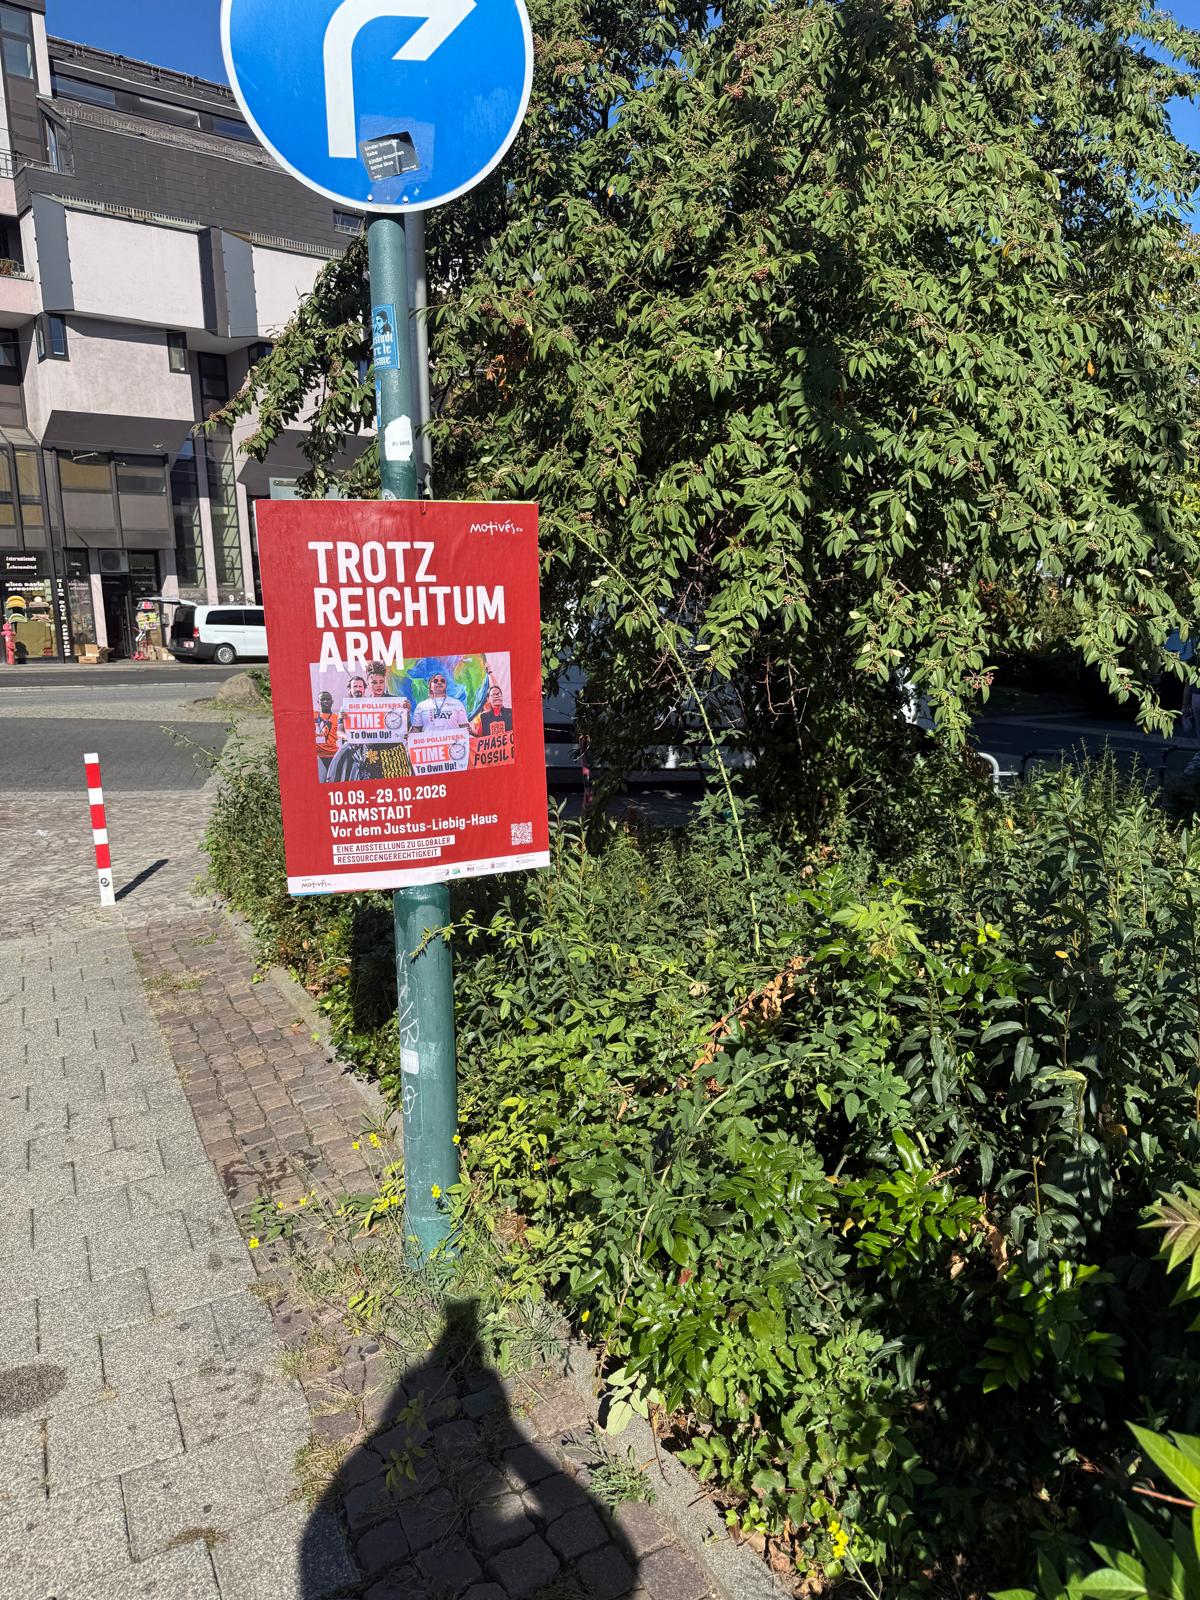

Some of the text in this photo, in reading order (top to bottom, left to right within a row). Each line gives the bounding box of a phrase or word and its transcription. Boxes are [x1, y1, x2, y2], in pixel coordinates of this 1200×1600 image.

[308, 541, 437, 583] TROTZ
[314, 586, 506, 628] REICHTUM
[319, 631, 405, 673] ARM
[348, 714, 381, 729] TIME
[433, 712, 453, 720] PAY
[350, 730, 392, 740] To Own Up!
[477, 735, 508, 752] PHASE
[413, 748, 446, 763] TIME
[473, 749, 509, 767] FOSSIL
[416, 762, 457, 774] To Own Up!
[328, 784, 447, 806] 10.09.-29.10.2026
[330, 805, 413, 823] DARMSTADT
[331, 813, 498, 838] Vor dem Justus-Liebig-Haus
[336, 837, 451, 854] EINE AUSSTELLUNG ZU GLOBALER
[337, 849, 438, 864] RESSOURCENGERECHTIGKEIT
